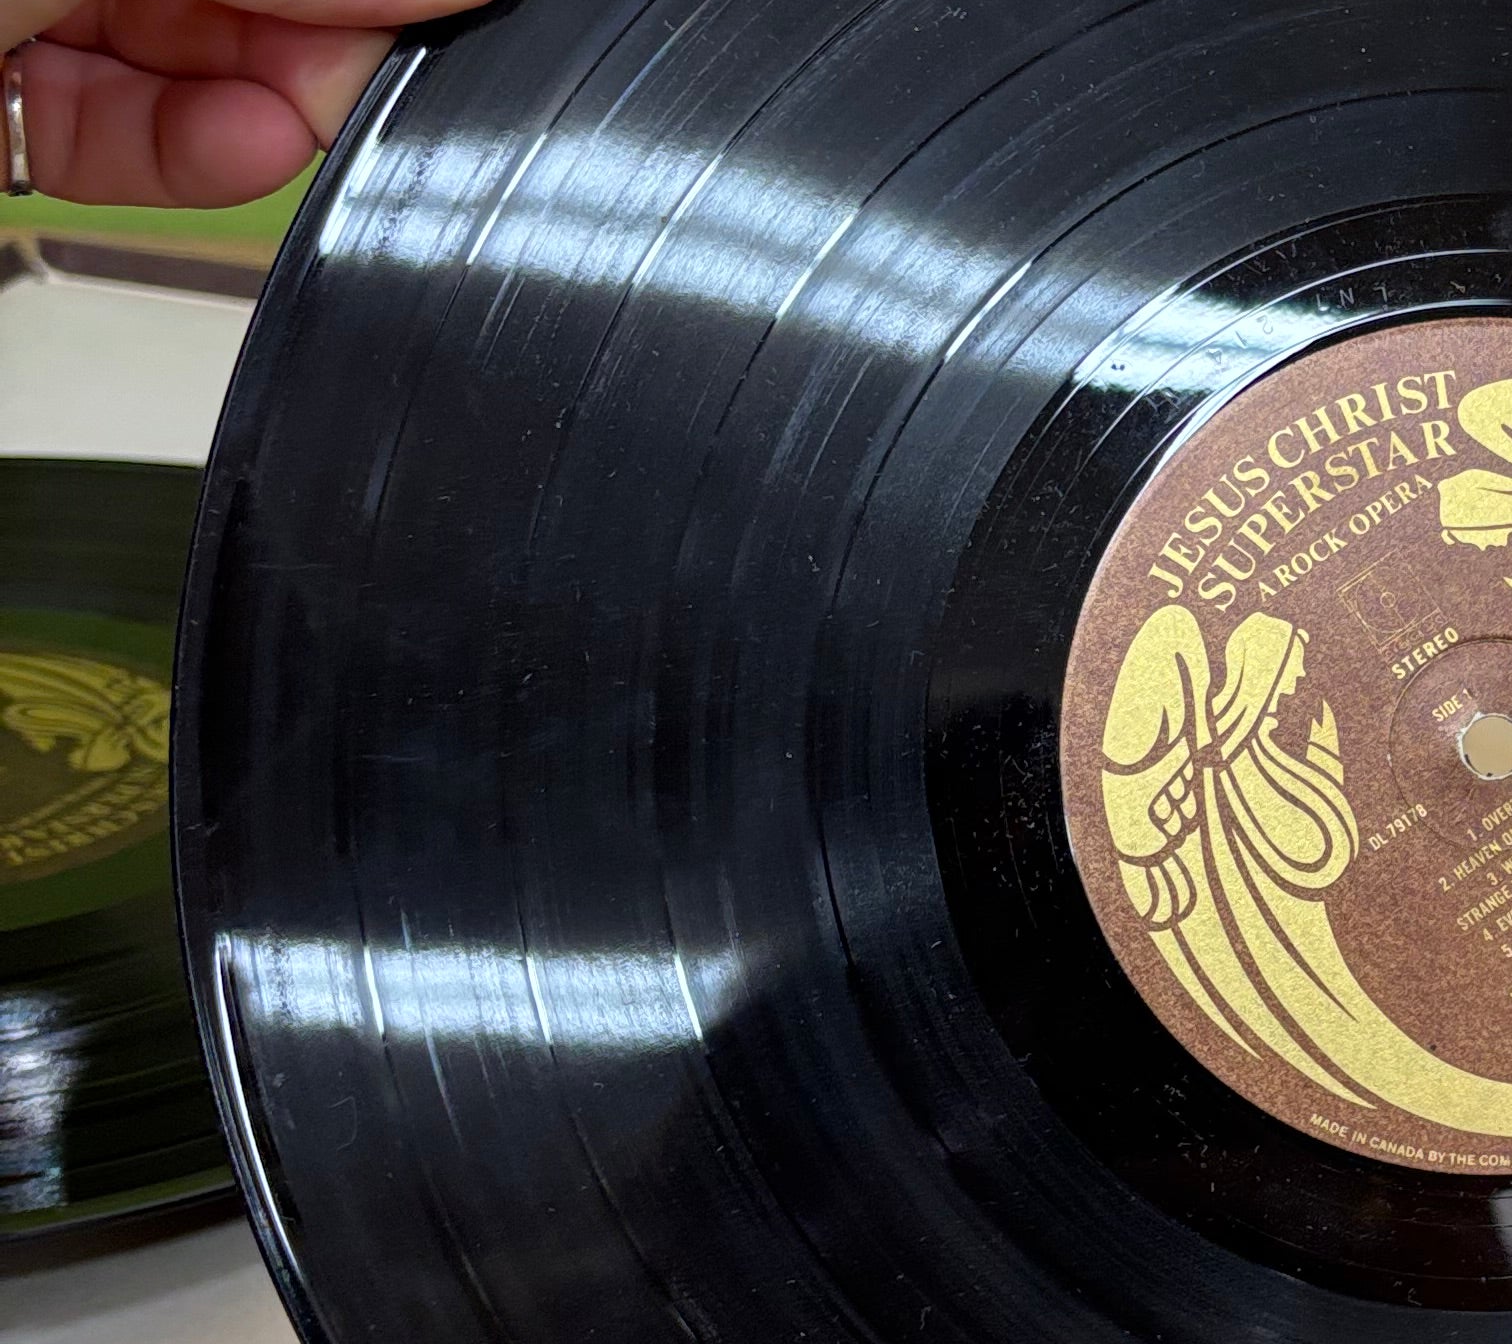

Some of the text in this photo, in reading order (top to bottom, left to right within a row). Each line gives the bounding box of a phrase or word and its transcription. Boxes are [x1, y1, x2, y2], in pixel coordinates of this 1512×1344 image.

[1148, 370, 1454, 598] JESUS CHRIST
[1198, 420, 1456, 612] SUPERSTAR
[1258, 474, 1433, 602] A ROCK OPERA
[1391, 627, 1458, 679] STEREO
[1432, 695, 1463, 722] SIDE
[1368, 833, 1389, 850] DL
[1453, 840, 1502, 880] HEAVEN
[1457, 885, 1512, 931] STRANGE
[1310, 1113, 1348, 1137] MADE
[1352, 1131, 1367, 1144] IN
[1369, 1136, 1424, 1159] CANADA
[1428, 1150, 1446, 1163] BY
